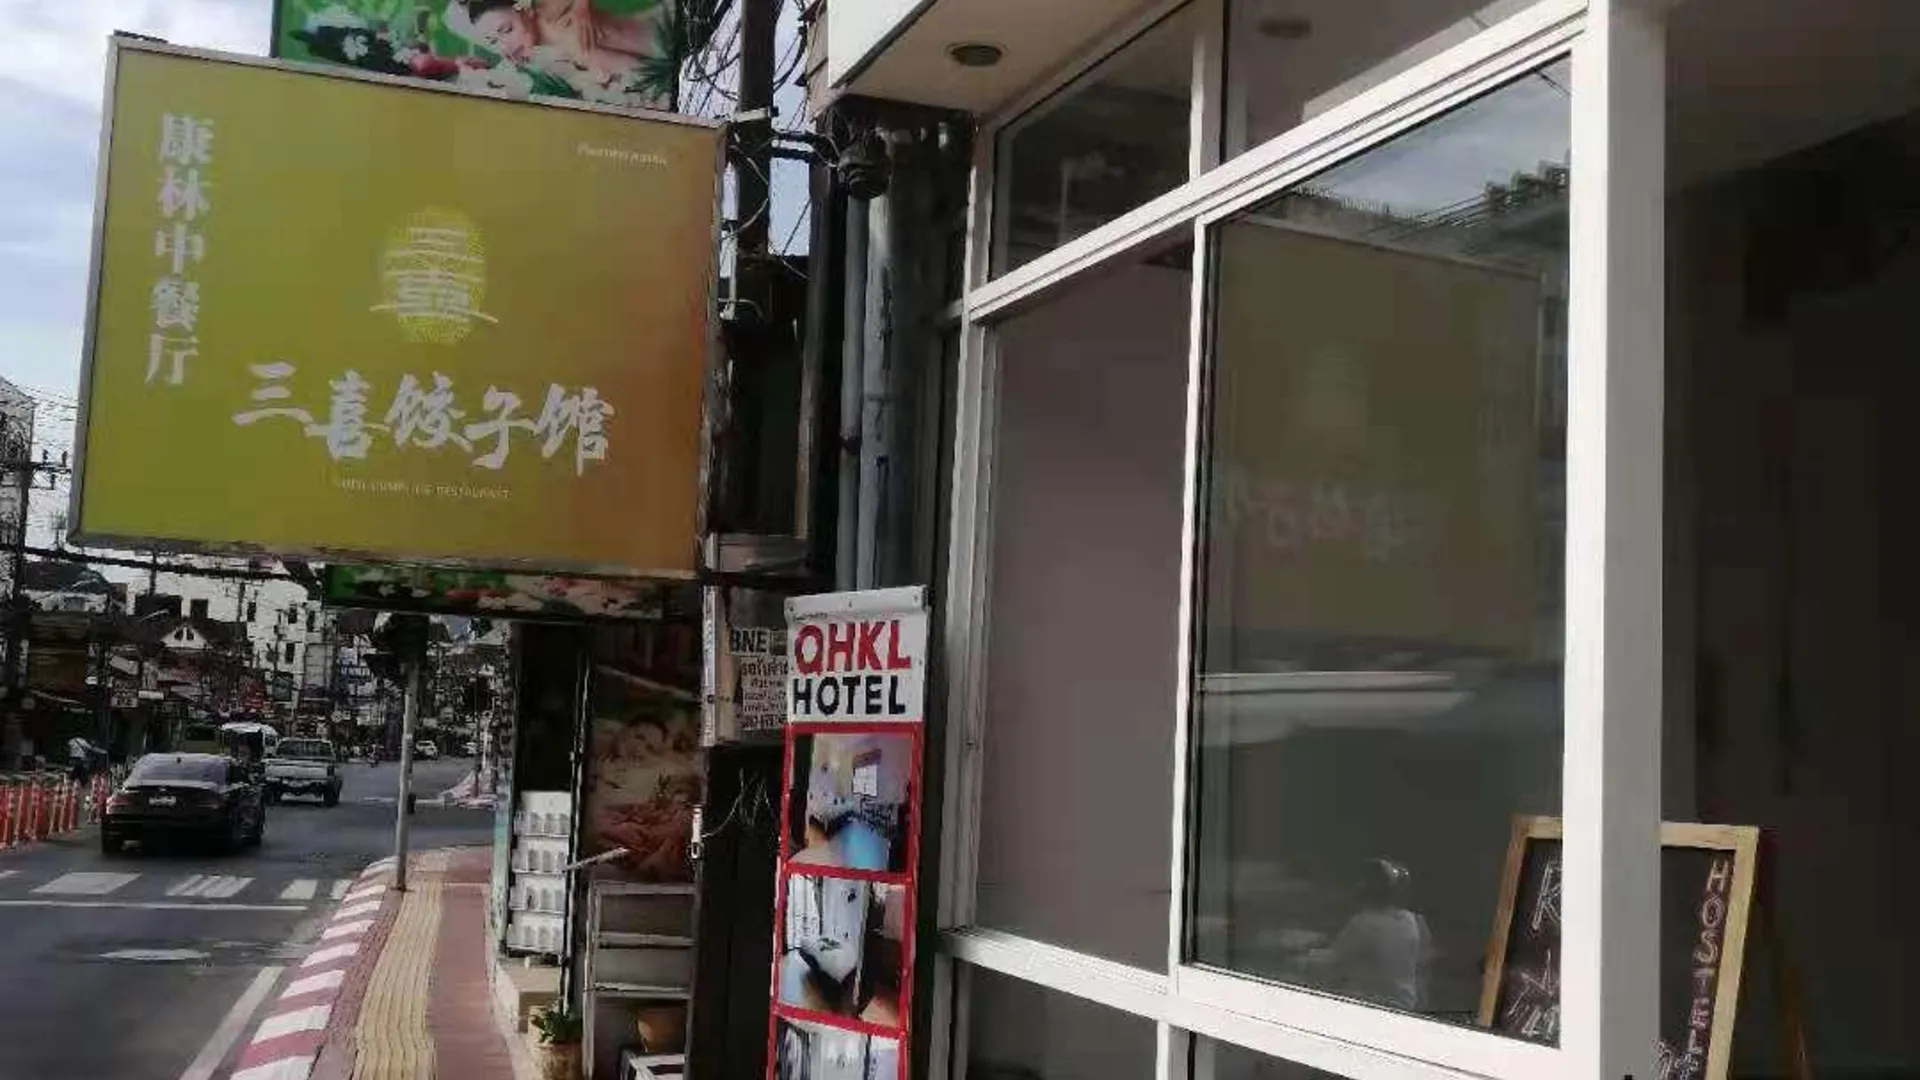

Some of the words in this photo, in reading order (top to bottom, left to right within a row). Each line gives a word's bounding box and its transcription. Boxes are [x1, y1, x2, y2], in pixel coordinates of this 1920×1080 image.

[146, 111, 214, 385] 康林中餐厅
[232, 361, 614, 477] 三喜饺子馆
[794, 619, 912, 676] QHKL
[793, 674, 907, 716] HOTEL
